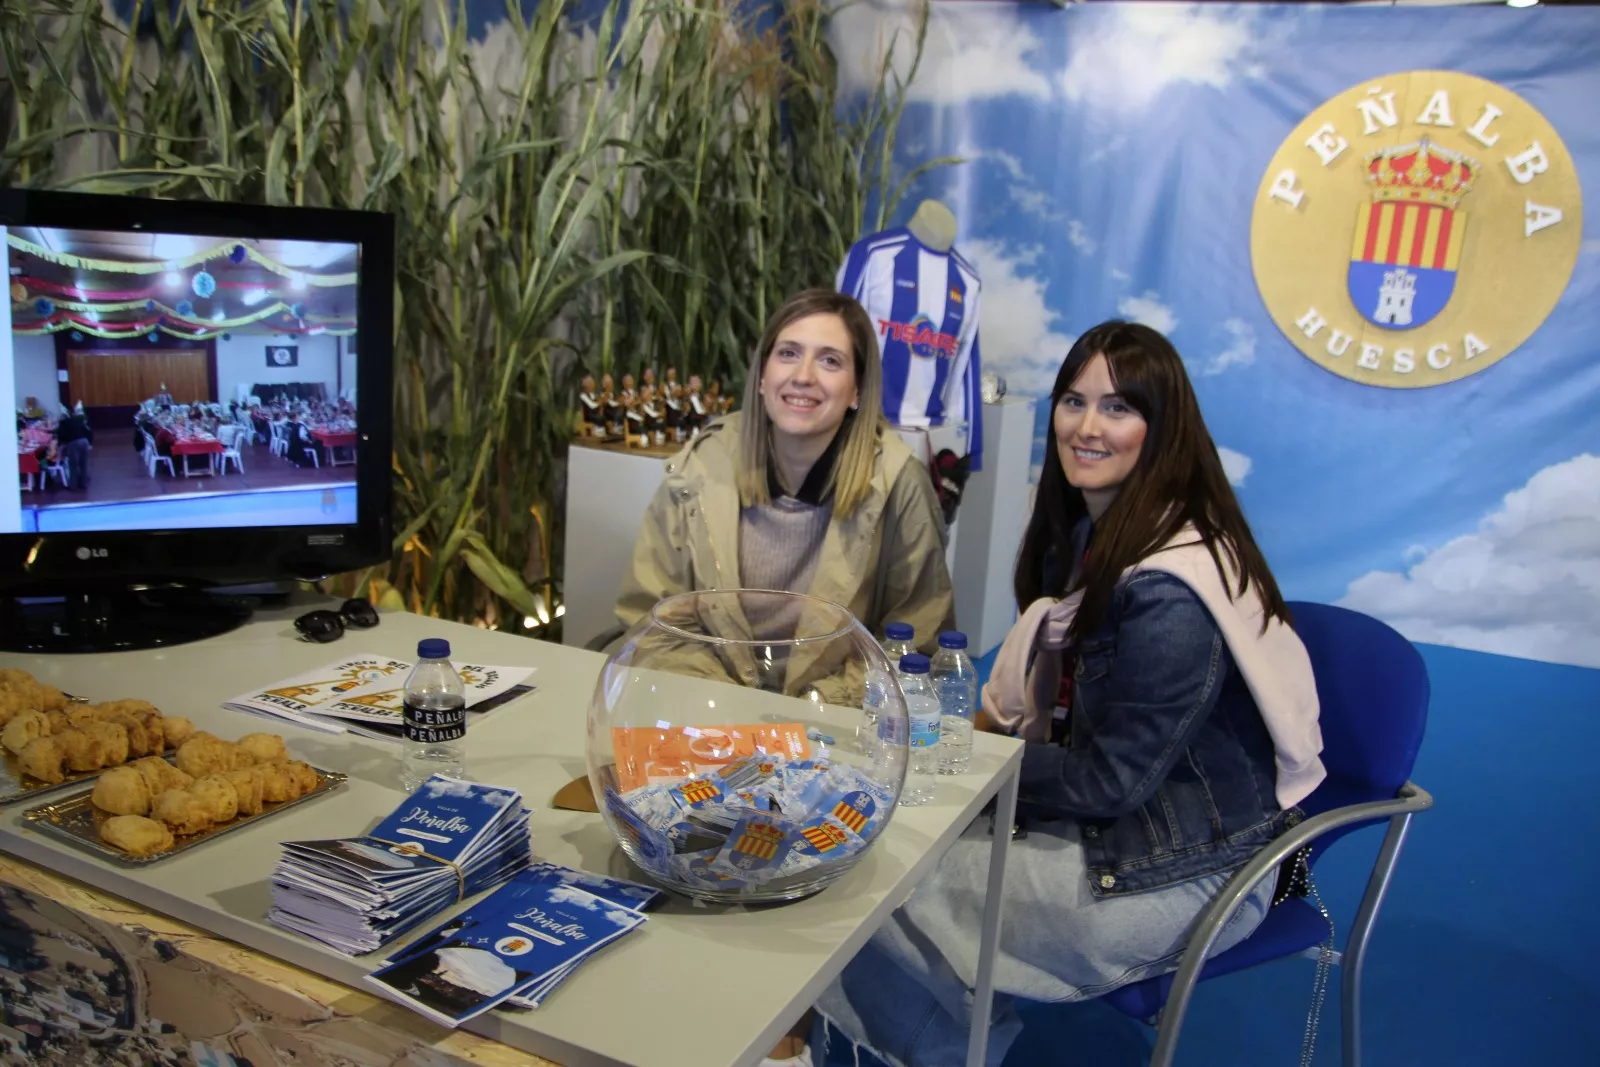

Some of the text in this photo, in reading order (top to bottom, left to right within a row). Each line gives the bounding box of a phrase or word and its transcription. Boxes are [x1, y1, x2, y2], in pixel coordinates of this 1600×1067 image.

[1268, 85, 1563, 238] PEÑALBA
[1295, 307, 1491, 375] HUESCA
[252, 693, 307, 712] PEÑALB
[400, 806, 472, 833] Peñalba
[514, 907, 589, 940] Peñalba
